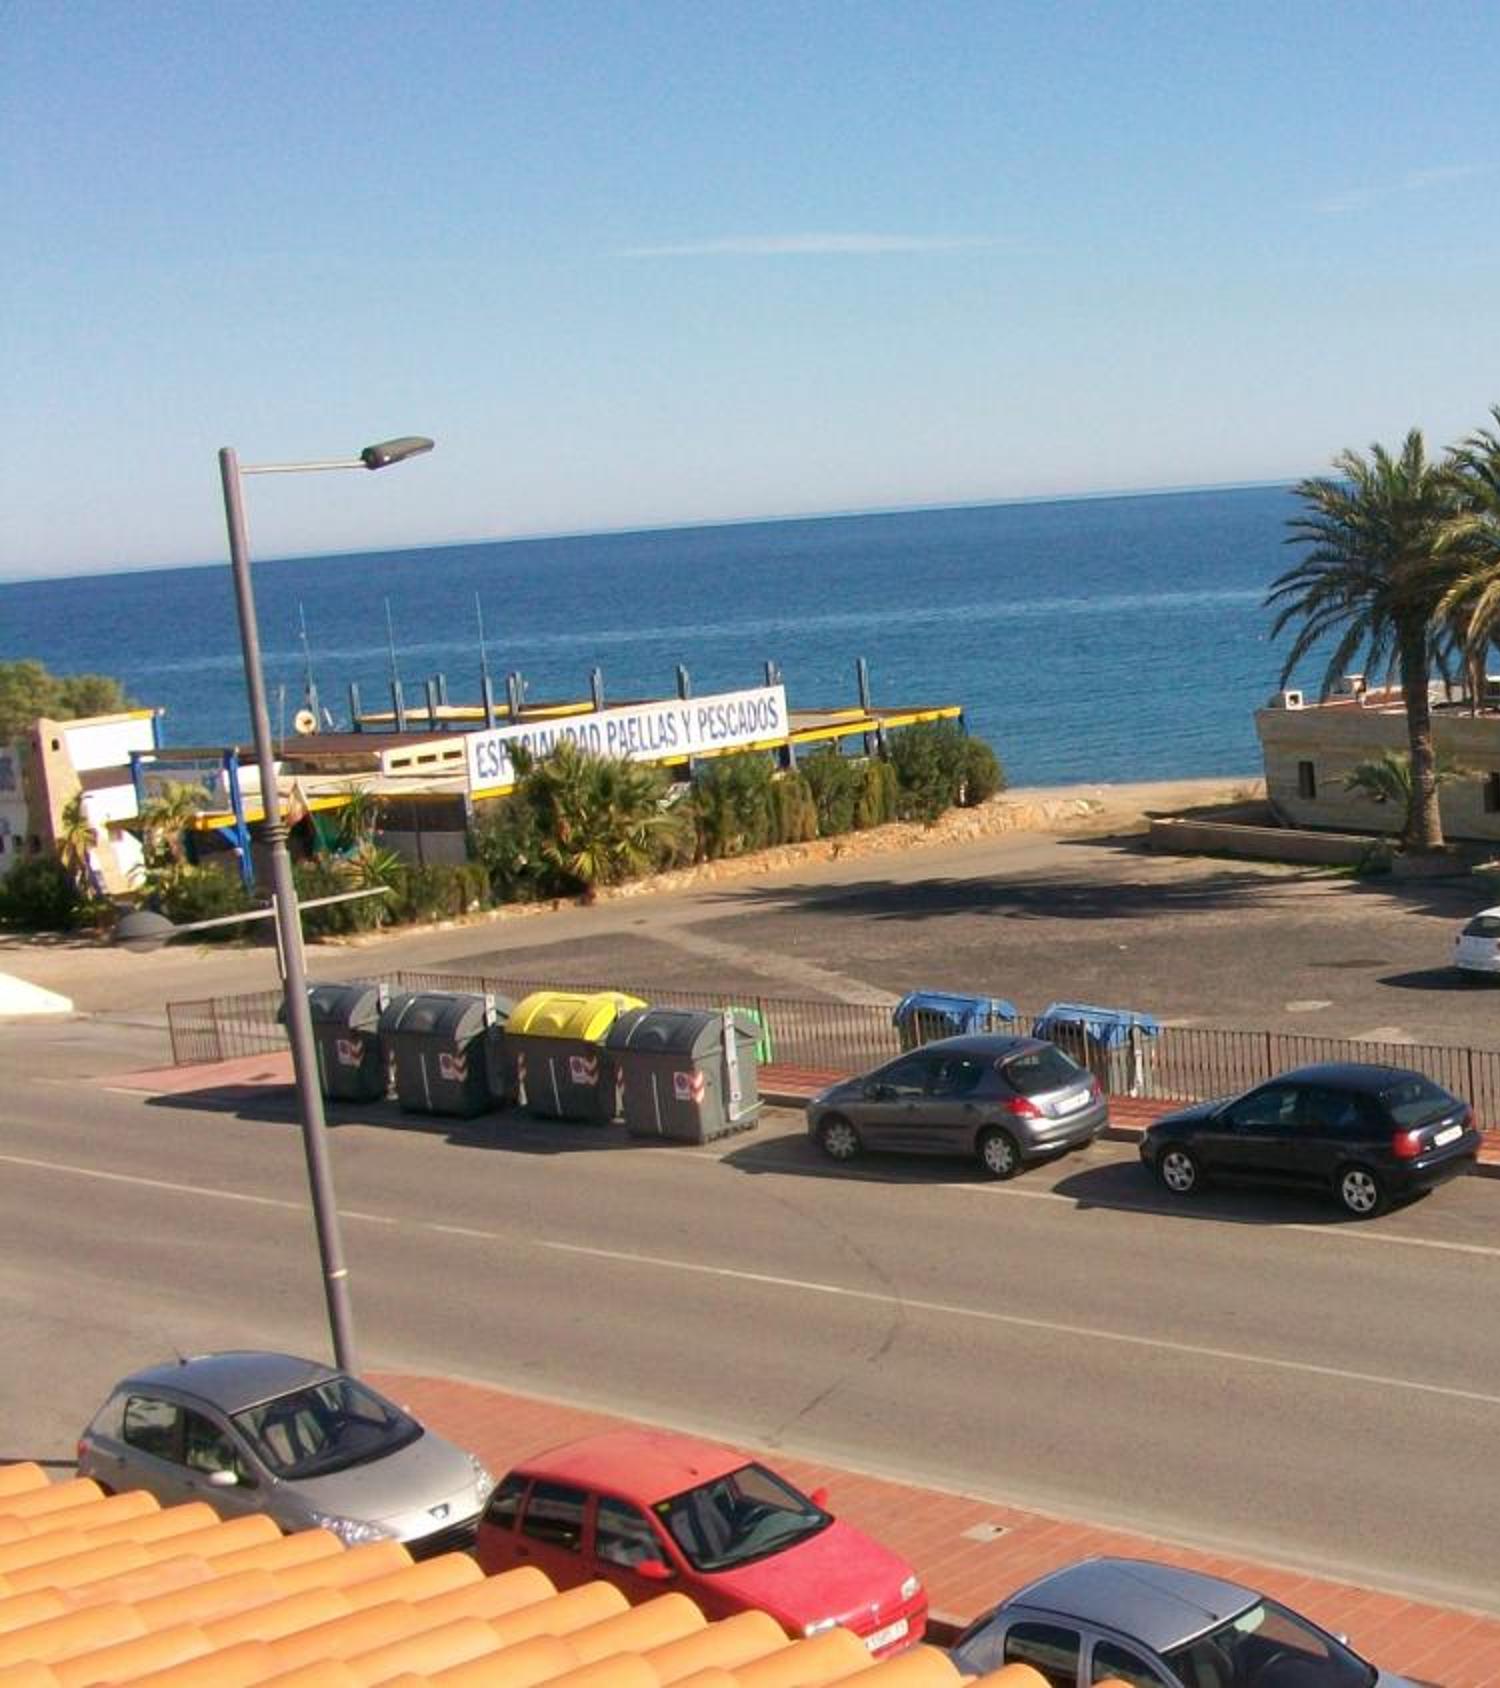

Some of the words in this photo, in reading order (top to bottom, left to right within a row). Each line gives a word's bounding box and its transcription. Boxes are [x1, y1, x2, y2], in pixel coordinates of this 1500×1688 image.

[475, 723, 601, 778] ESPIALDAD
[606, 711, 678, 754] PAELLAS
[681, 709, 692, 744] Y
[699, 696, 779, 741] PESCADOS
